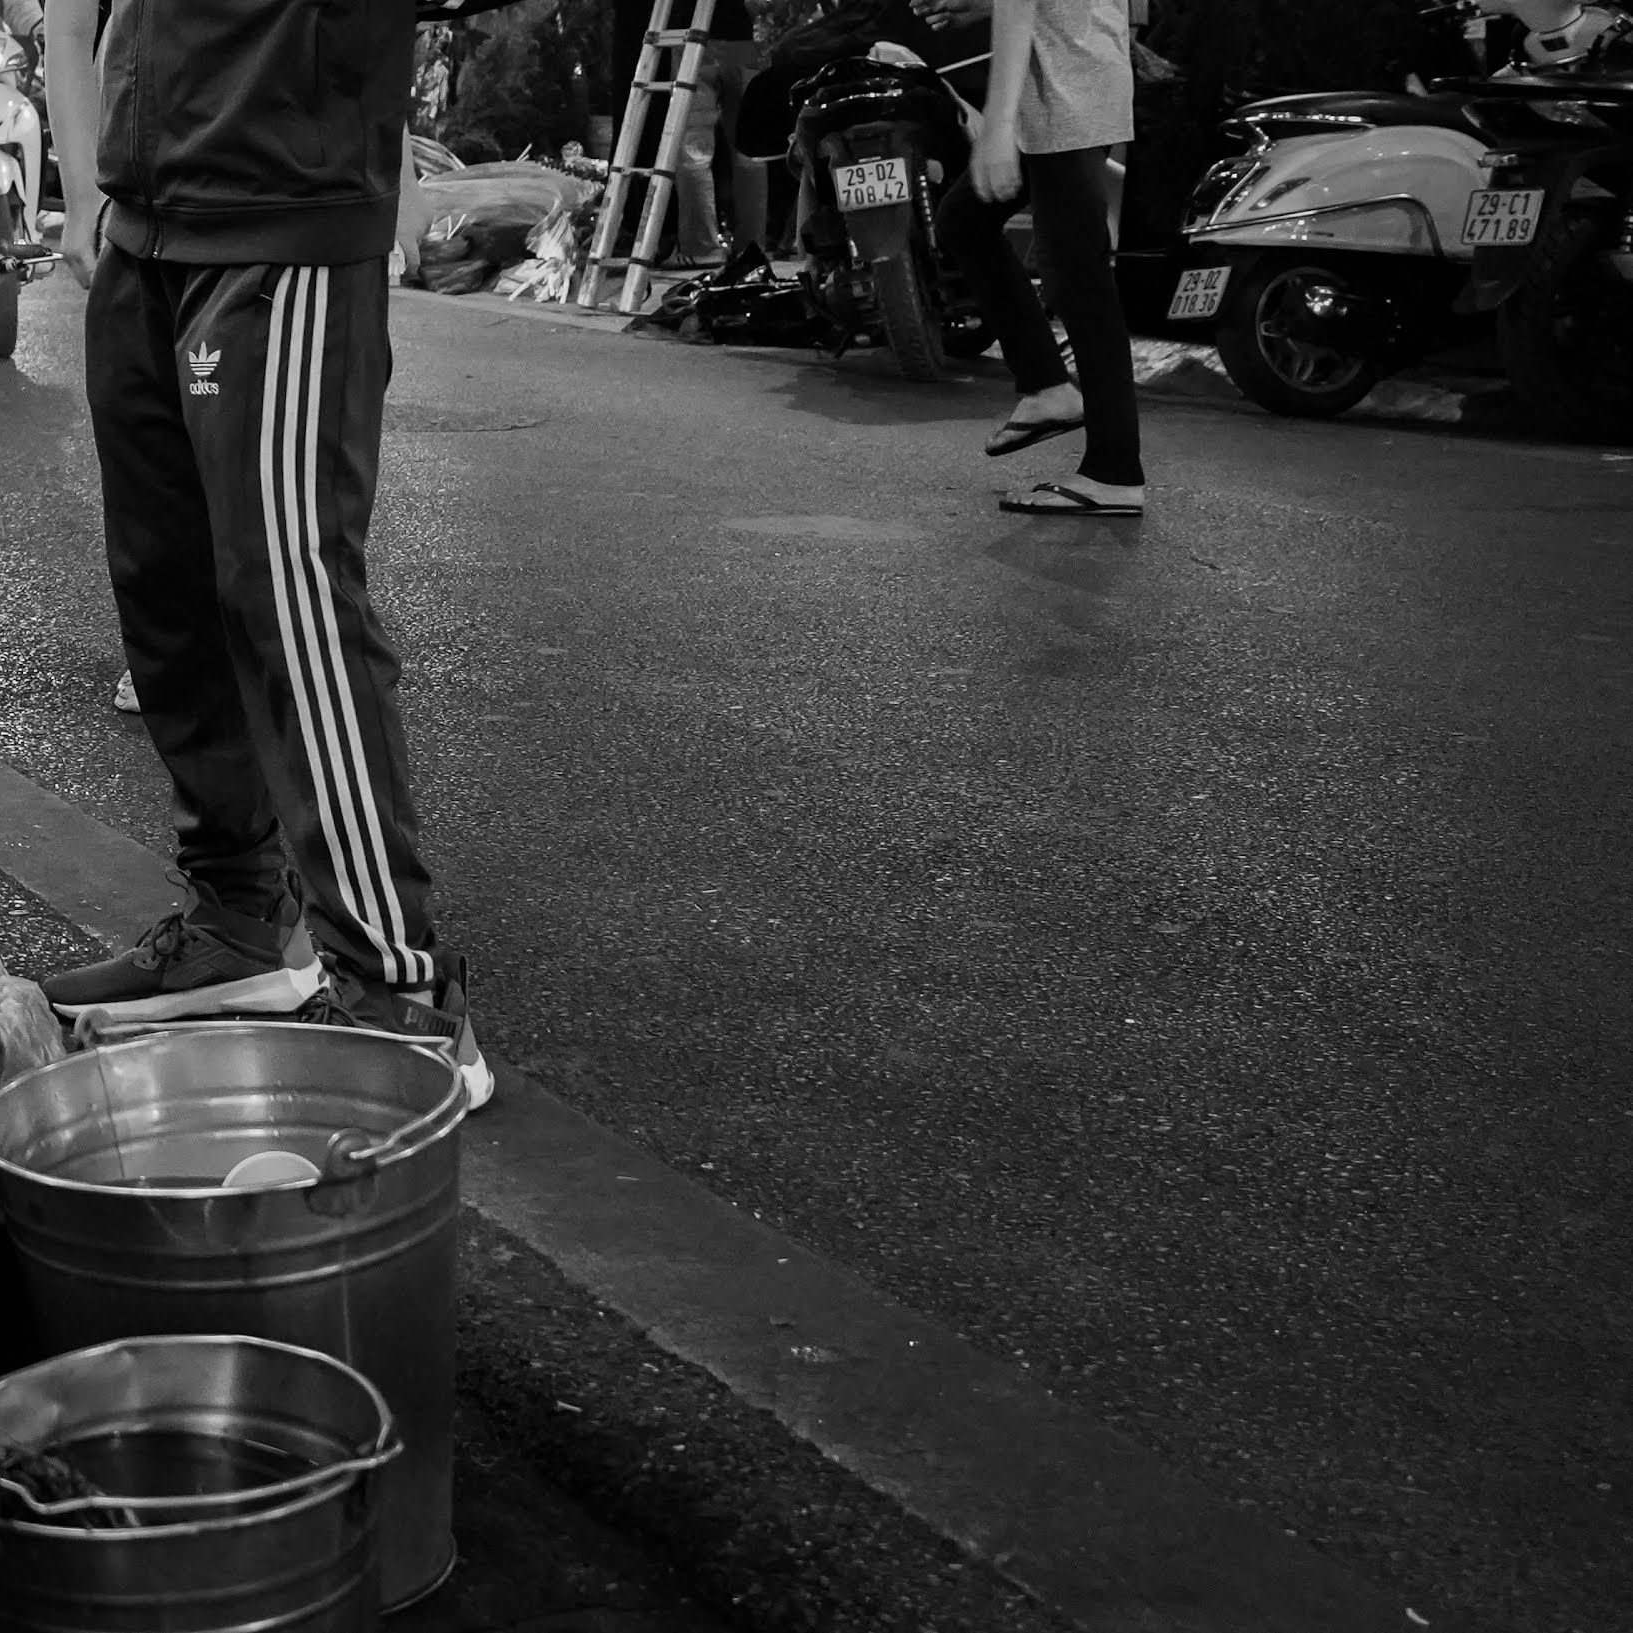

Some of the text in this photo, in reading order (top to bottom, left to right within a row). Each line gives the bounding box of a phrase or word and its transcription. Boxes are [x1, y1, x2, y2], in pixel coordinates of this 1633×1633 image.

[846, 162, 896, 187] 29-D2
[842, 182, 906, 207] 708.42
[1477, 193, 1531, 216] 29-C1
[1467, 218, 1531, 242] 471.89
